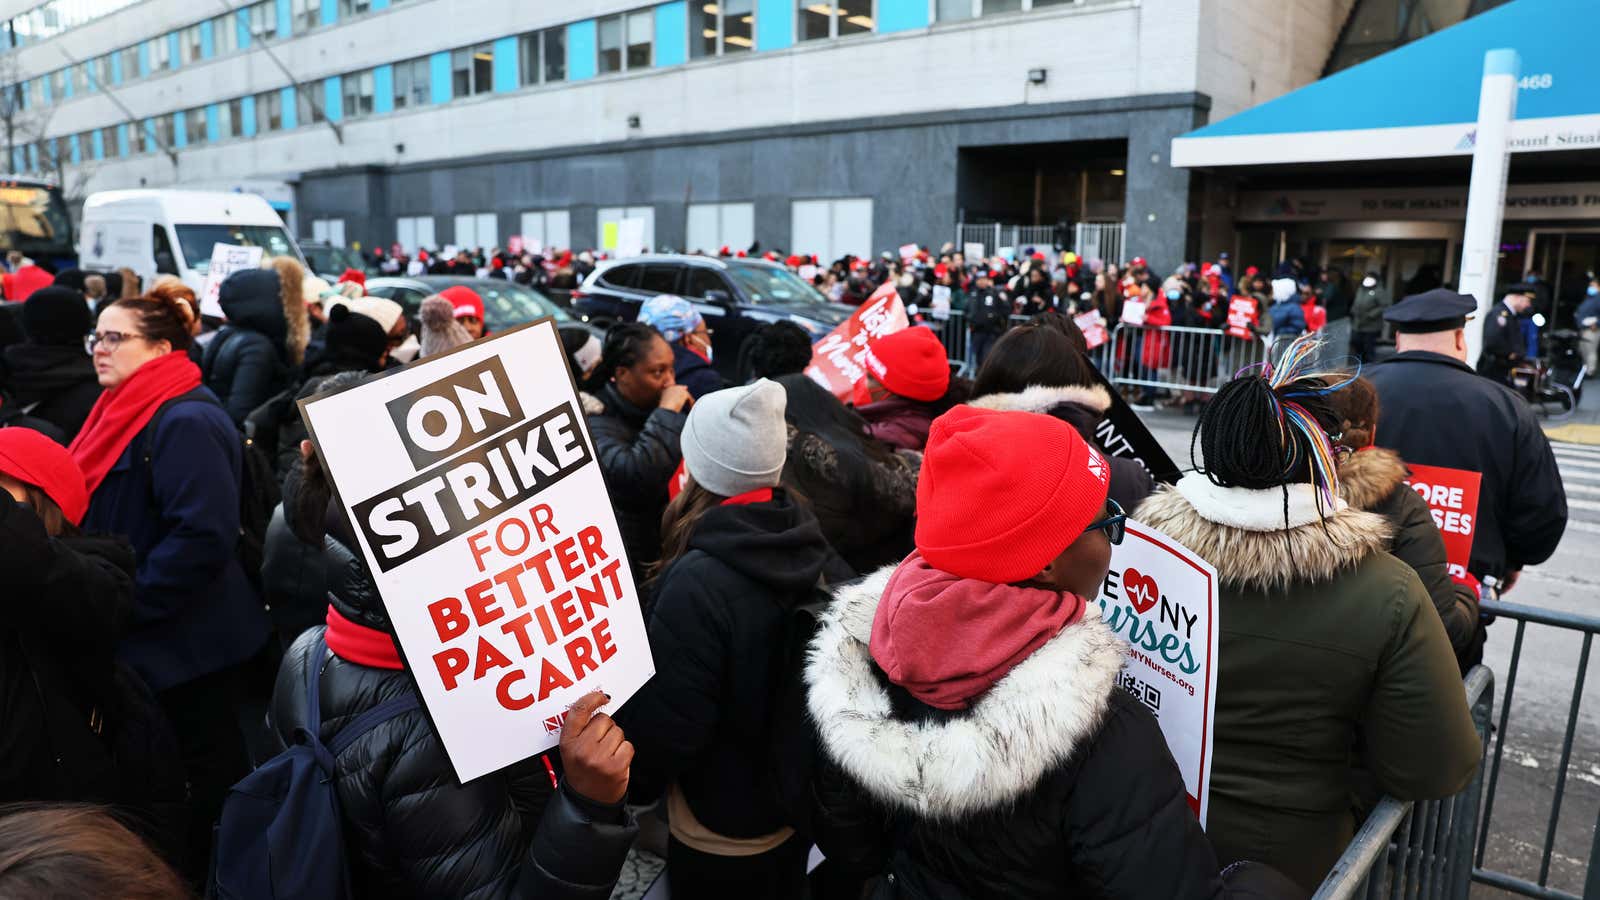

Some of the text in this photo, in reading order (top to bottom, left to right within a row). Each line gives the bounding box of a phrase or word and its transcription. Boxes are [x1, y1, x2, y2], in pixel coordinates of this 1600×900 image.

[1503, 134, 1549, 148] ount
[1383, 198, 1407, 210] THE
[1408, 196, 1461, 210] HEALTH
[406, 370, 511, 451] ON
[368, 412, 584, 558] STRIKE
[1402, 481, 1464, 509] ORE
[467, 503, 560, 572] FOR
[1430, 509, 1472, 535] SES
[428, 526, 608, 643] BETTER
[1103, 569, 1198, 639] E NY
[432, 559, 623, 691] PATIENT
[1099, 598, 1201, 675] urses
[496, 618, 617, 710] CARE
[1127, 648, 1196, 697] NYNurses.org
